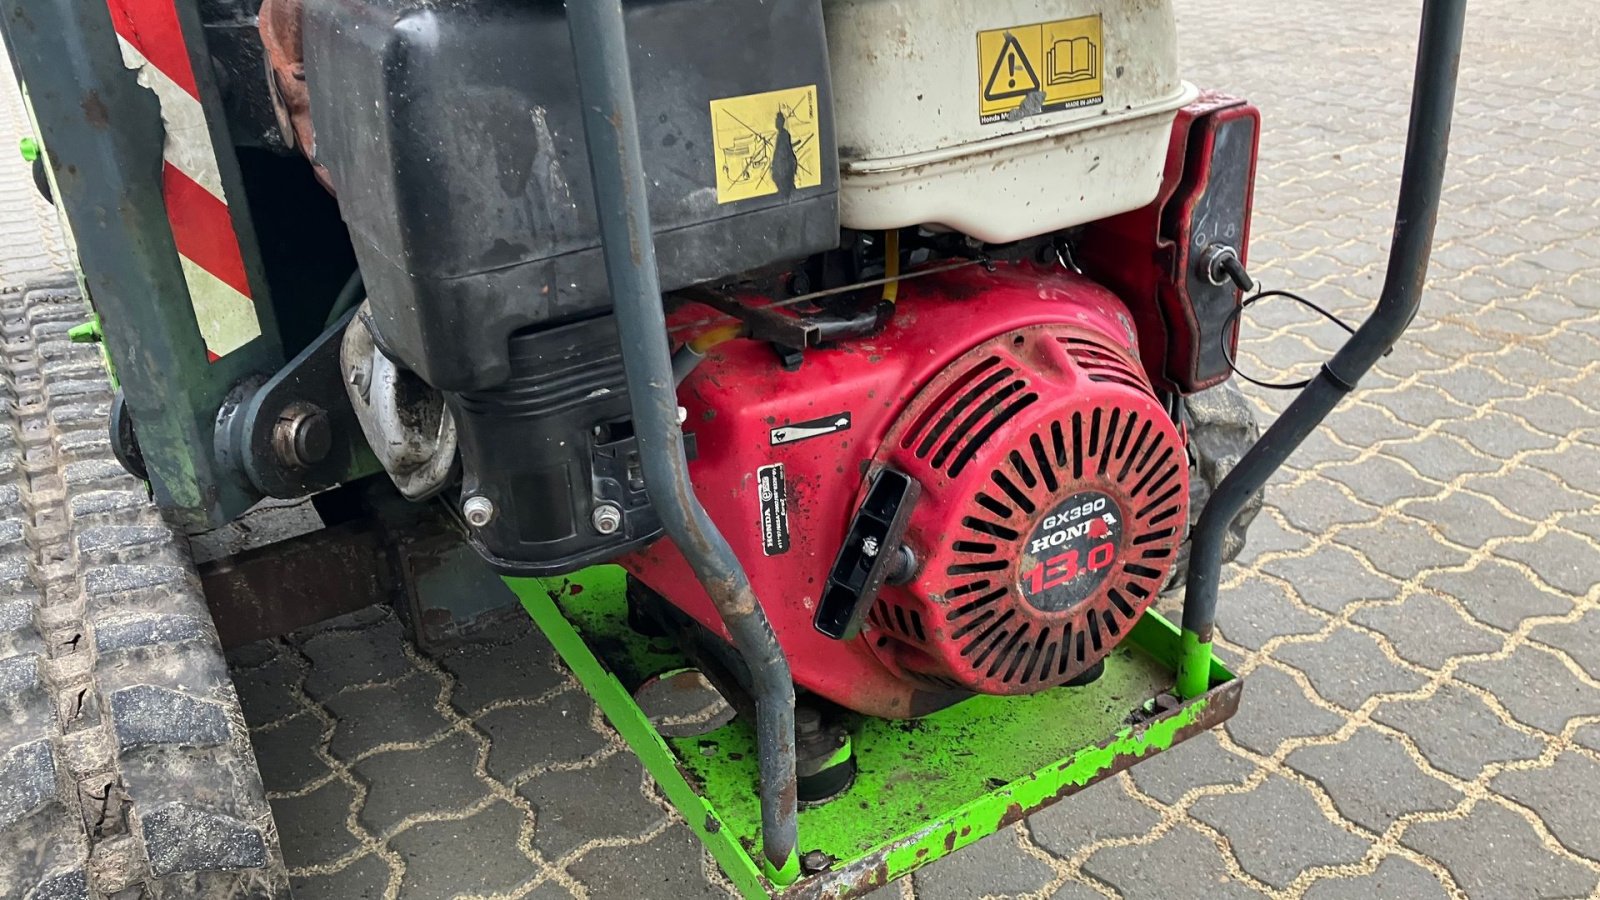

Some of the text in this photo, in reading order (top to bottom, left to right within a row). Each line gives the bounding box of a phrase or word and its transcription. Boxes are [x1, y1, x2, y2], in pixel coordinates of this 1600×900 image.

[1065, 100, 1079, 108] MADE
[1086, 96, 1102, 105] JAPAN
[981, 114, 1000, 124] Honda
[764, 508, 773, 547] HONDA
[1043, 498, 1106, 530] GX390
[1023, 542, 1115, 595] 13.0
